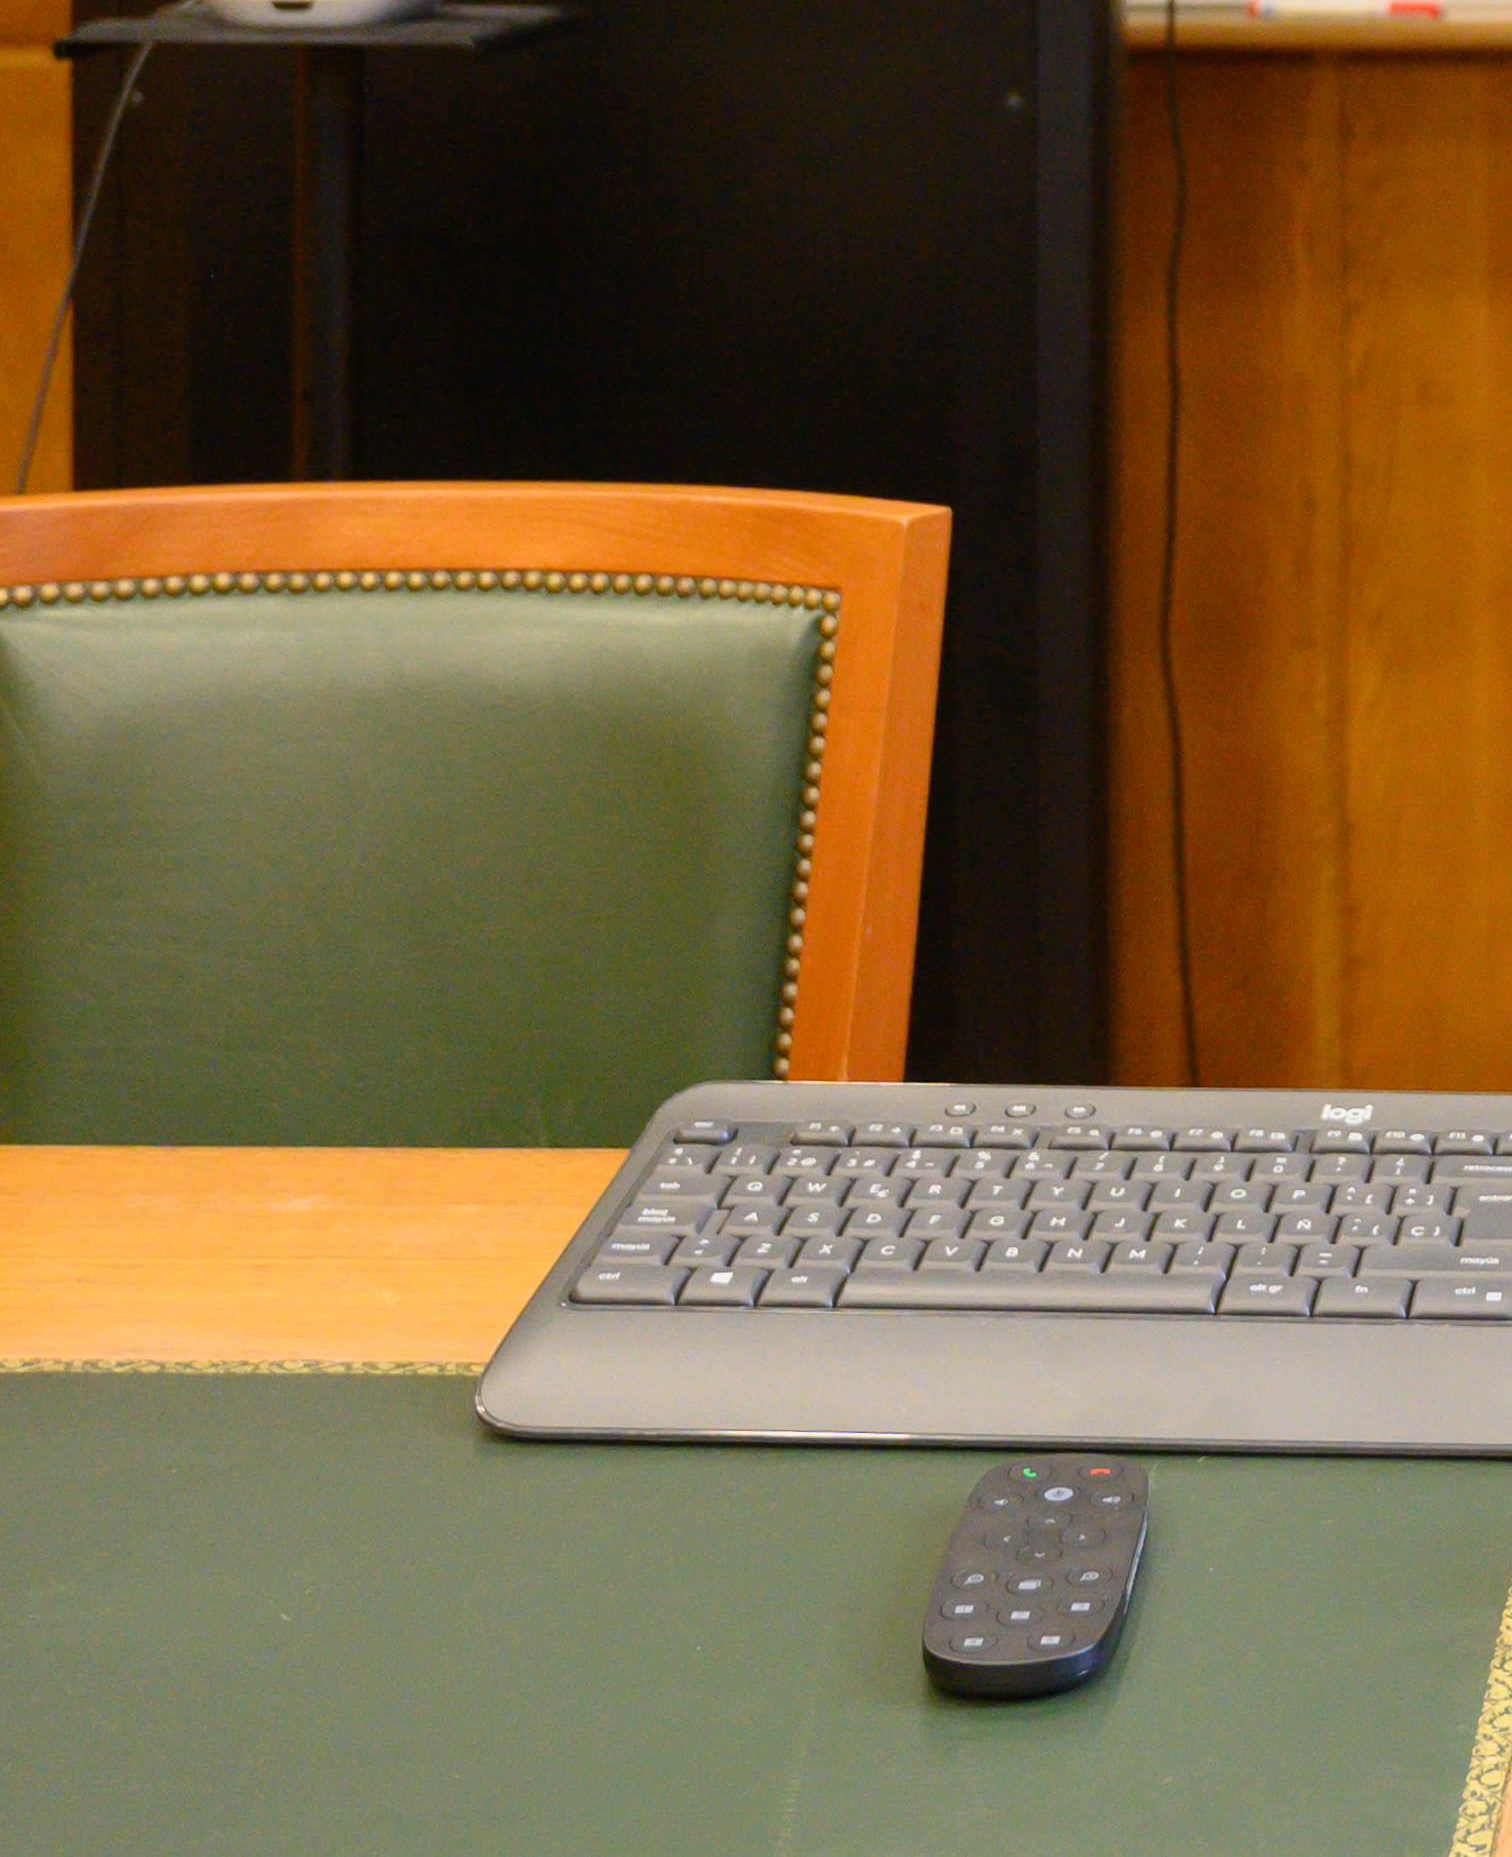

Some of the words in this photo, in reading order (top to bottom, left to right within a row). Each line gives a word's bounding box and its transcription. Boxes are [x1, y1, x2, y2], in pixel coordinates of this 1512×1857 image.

[1321, 1104, 1373, 1125] logi
[660, 1182, 681, 1190] tab
[746, 1181, 763, 1192] Q
[807, 1182, 827, 1193] W
[869, 1183, 881, 1194] E
[928, 1184, 942, 1195] R
[992, 1185, 1004, 1195] T
[1052, 1186, 1065, 1196] Y
[1110, 1187, 1125, 1197] U
[1230, 1188, 1247, 1199] O
[1292, 1189, 1306, 1199] P
[744, 1212, 759, 1222] A
[807, 1212, 819, 1223] S
[866, 1213, 882, 1223] D
[929, 1214, 942, 1225] F
[989, 1215, 1005, 1225] G
[1050, 1216, 1066, 1226] H
[1114, 1217, 1126, 1228] J
[1173, 1218, 1187, 1228] K
[1236, 1219, 1246, 1229] L
[1296, 1218, 1312, 1230] Ñ
[756, 1243, 772, 1253] Z
[819, 1244, 833, 1255] X
[880, 1245, 896, 1255] C
[945, 1246, 958, 1256] V
[1005, 1247, 1019, 1257] B
[1066, 1247, 1083, 1258] N
[1128, 1249, 1146, 1259] M
[598, 1271, 621, 1281] ctrl
[791, 1275, 808, 1284] alt
[1249, 1283, 1267, 1292] alt
[1268, 1284, 1284, 1294] gr
[1355, 1285, 1368, 1293] fn
[1455, 1287, 1476, 1295] ctrl
